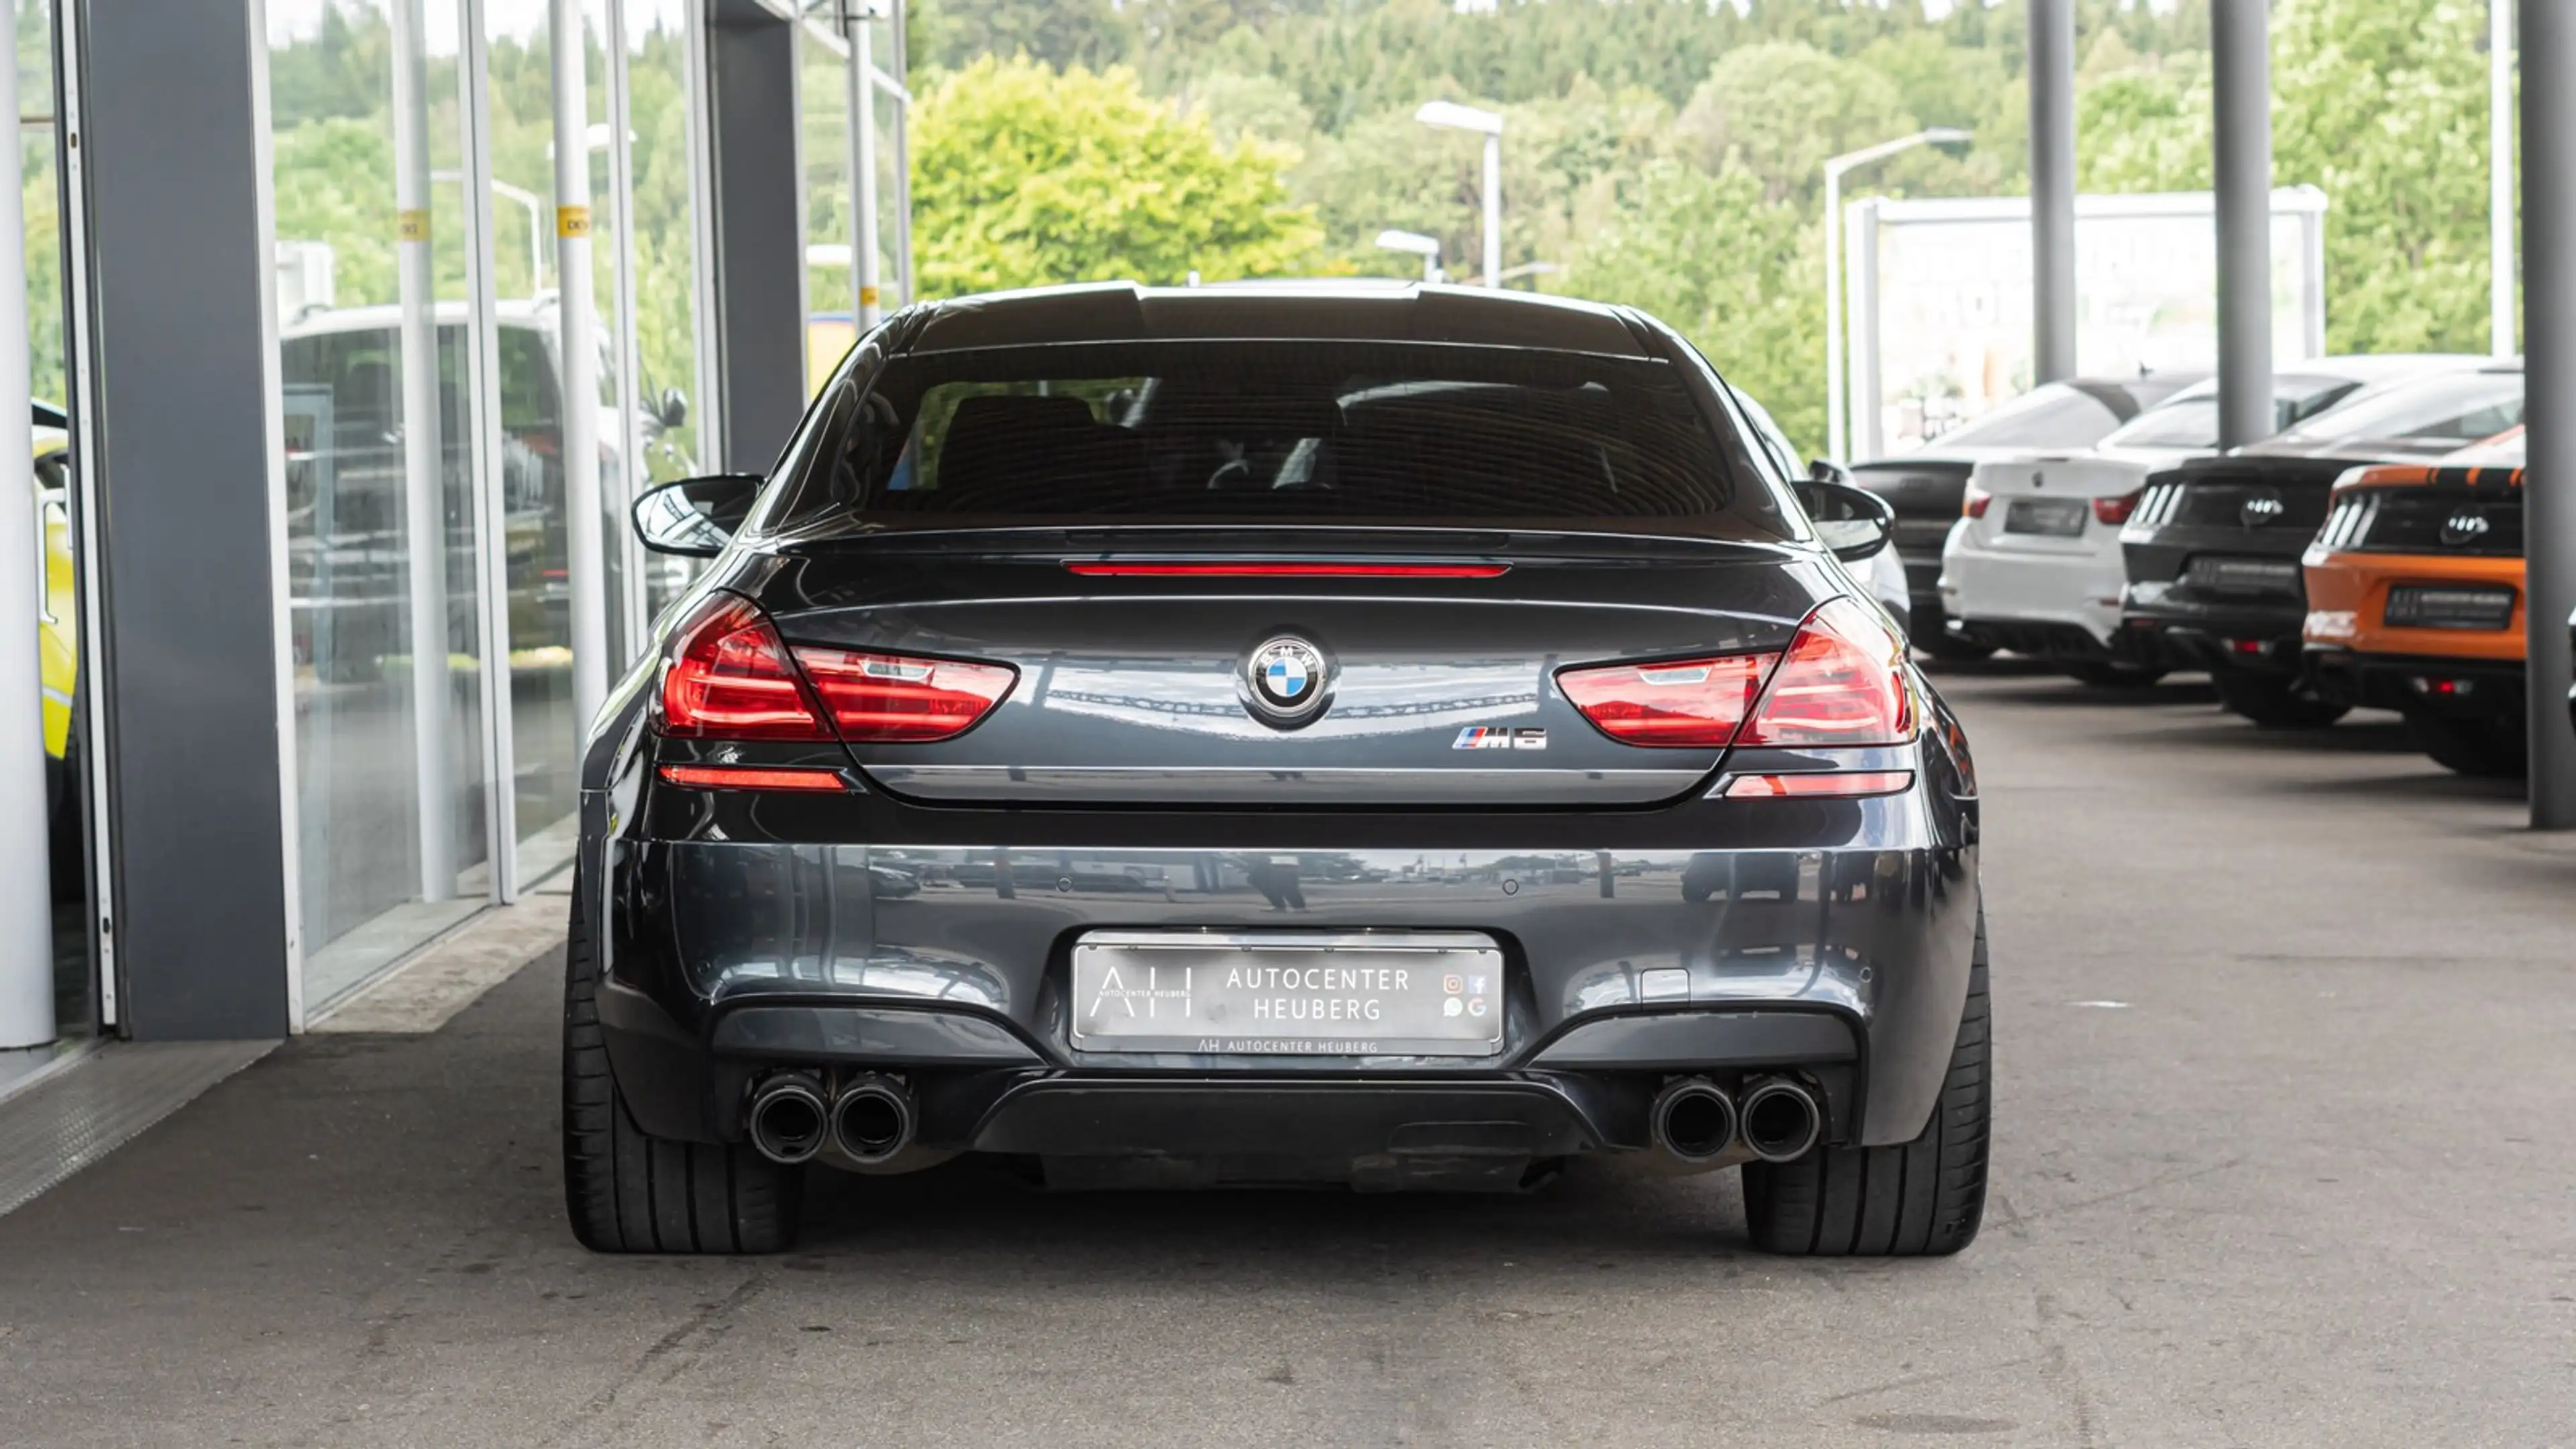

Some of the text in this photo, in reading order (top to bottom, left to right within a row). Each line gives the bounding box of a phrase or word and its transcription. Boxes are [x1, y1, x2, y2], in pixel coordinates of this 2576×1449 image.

[1259, 647, 1314, 666] BMW
[1470, 727, 1547, 749] M6
[1227, 967, 1409, 991] AUTOCENTER
[1098, 989, 1152, 998] AUTOCENTER
[1254, 998, 1381, 1020] HEUBERG
[1198, 1039, 1378, 1053] AH AUTOCENTER HEUBERG
